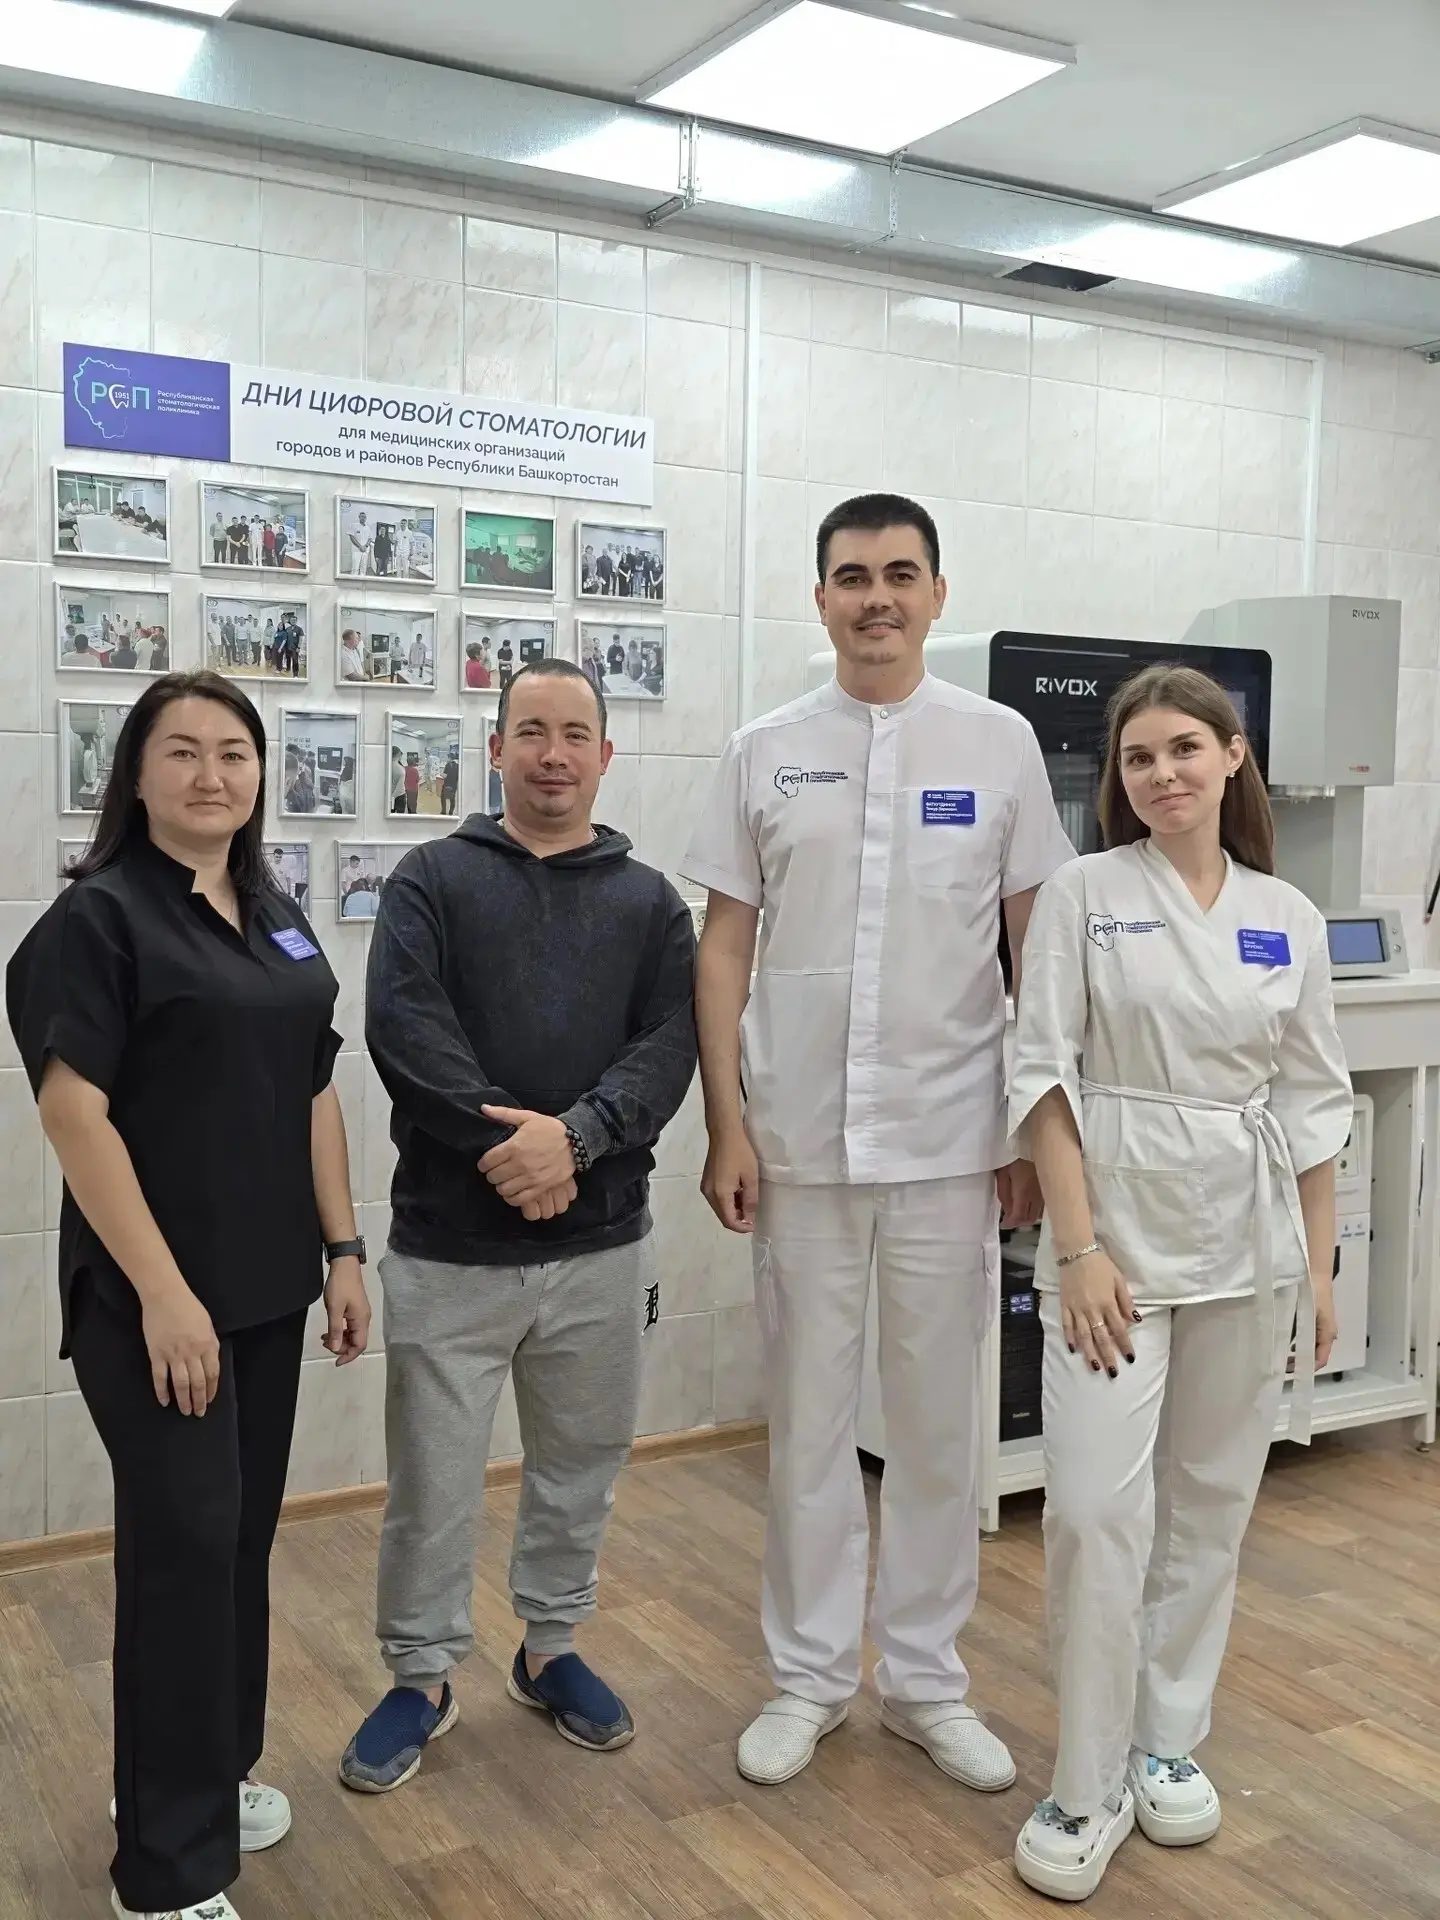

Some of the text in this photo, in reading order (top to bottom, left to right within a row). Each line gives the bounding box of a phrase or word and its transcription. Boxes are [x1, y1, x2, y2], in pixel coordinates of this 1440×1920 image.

[114, 391, 130, 400] 1951
[157, 389, 214, 402] Республиканская
[157, 398, 220, 410] стоматологическая
[157, 405, 200, 415] поликлиника
[241, 382, 646, 450] ДНИ ЦИФРОВОЙ СТОМАТОЛОГИИ
[338, 426, 566, 462] для медицинских организаций
[276, 440, 619, 488] городов и районов Республики Башкортостан
